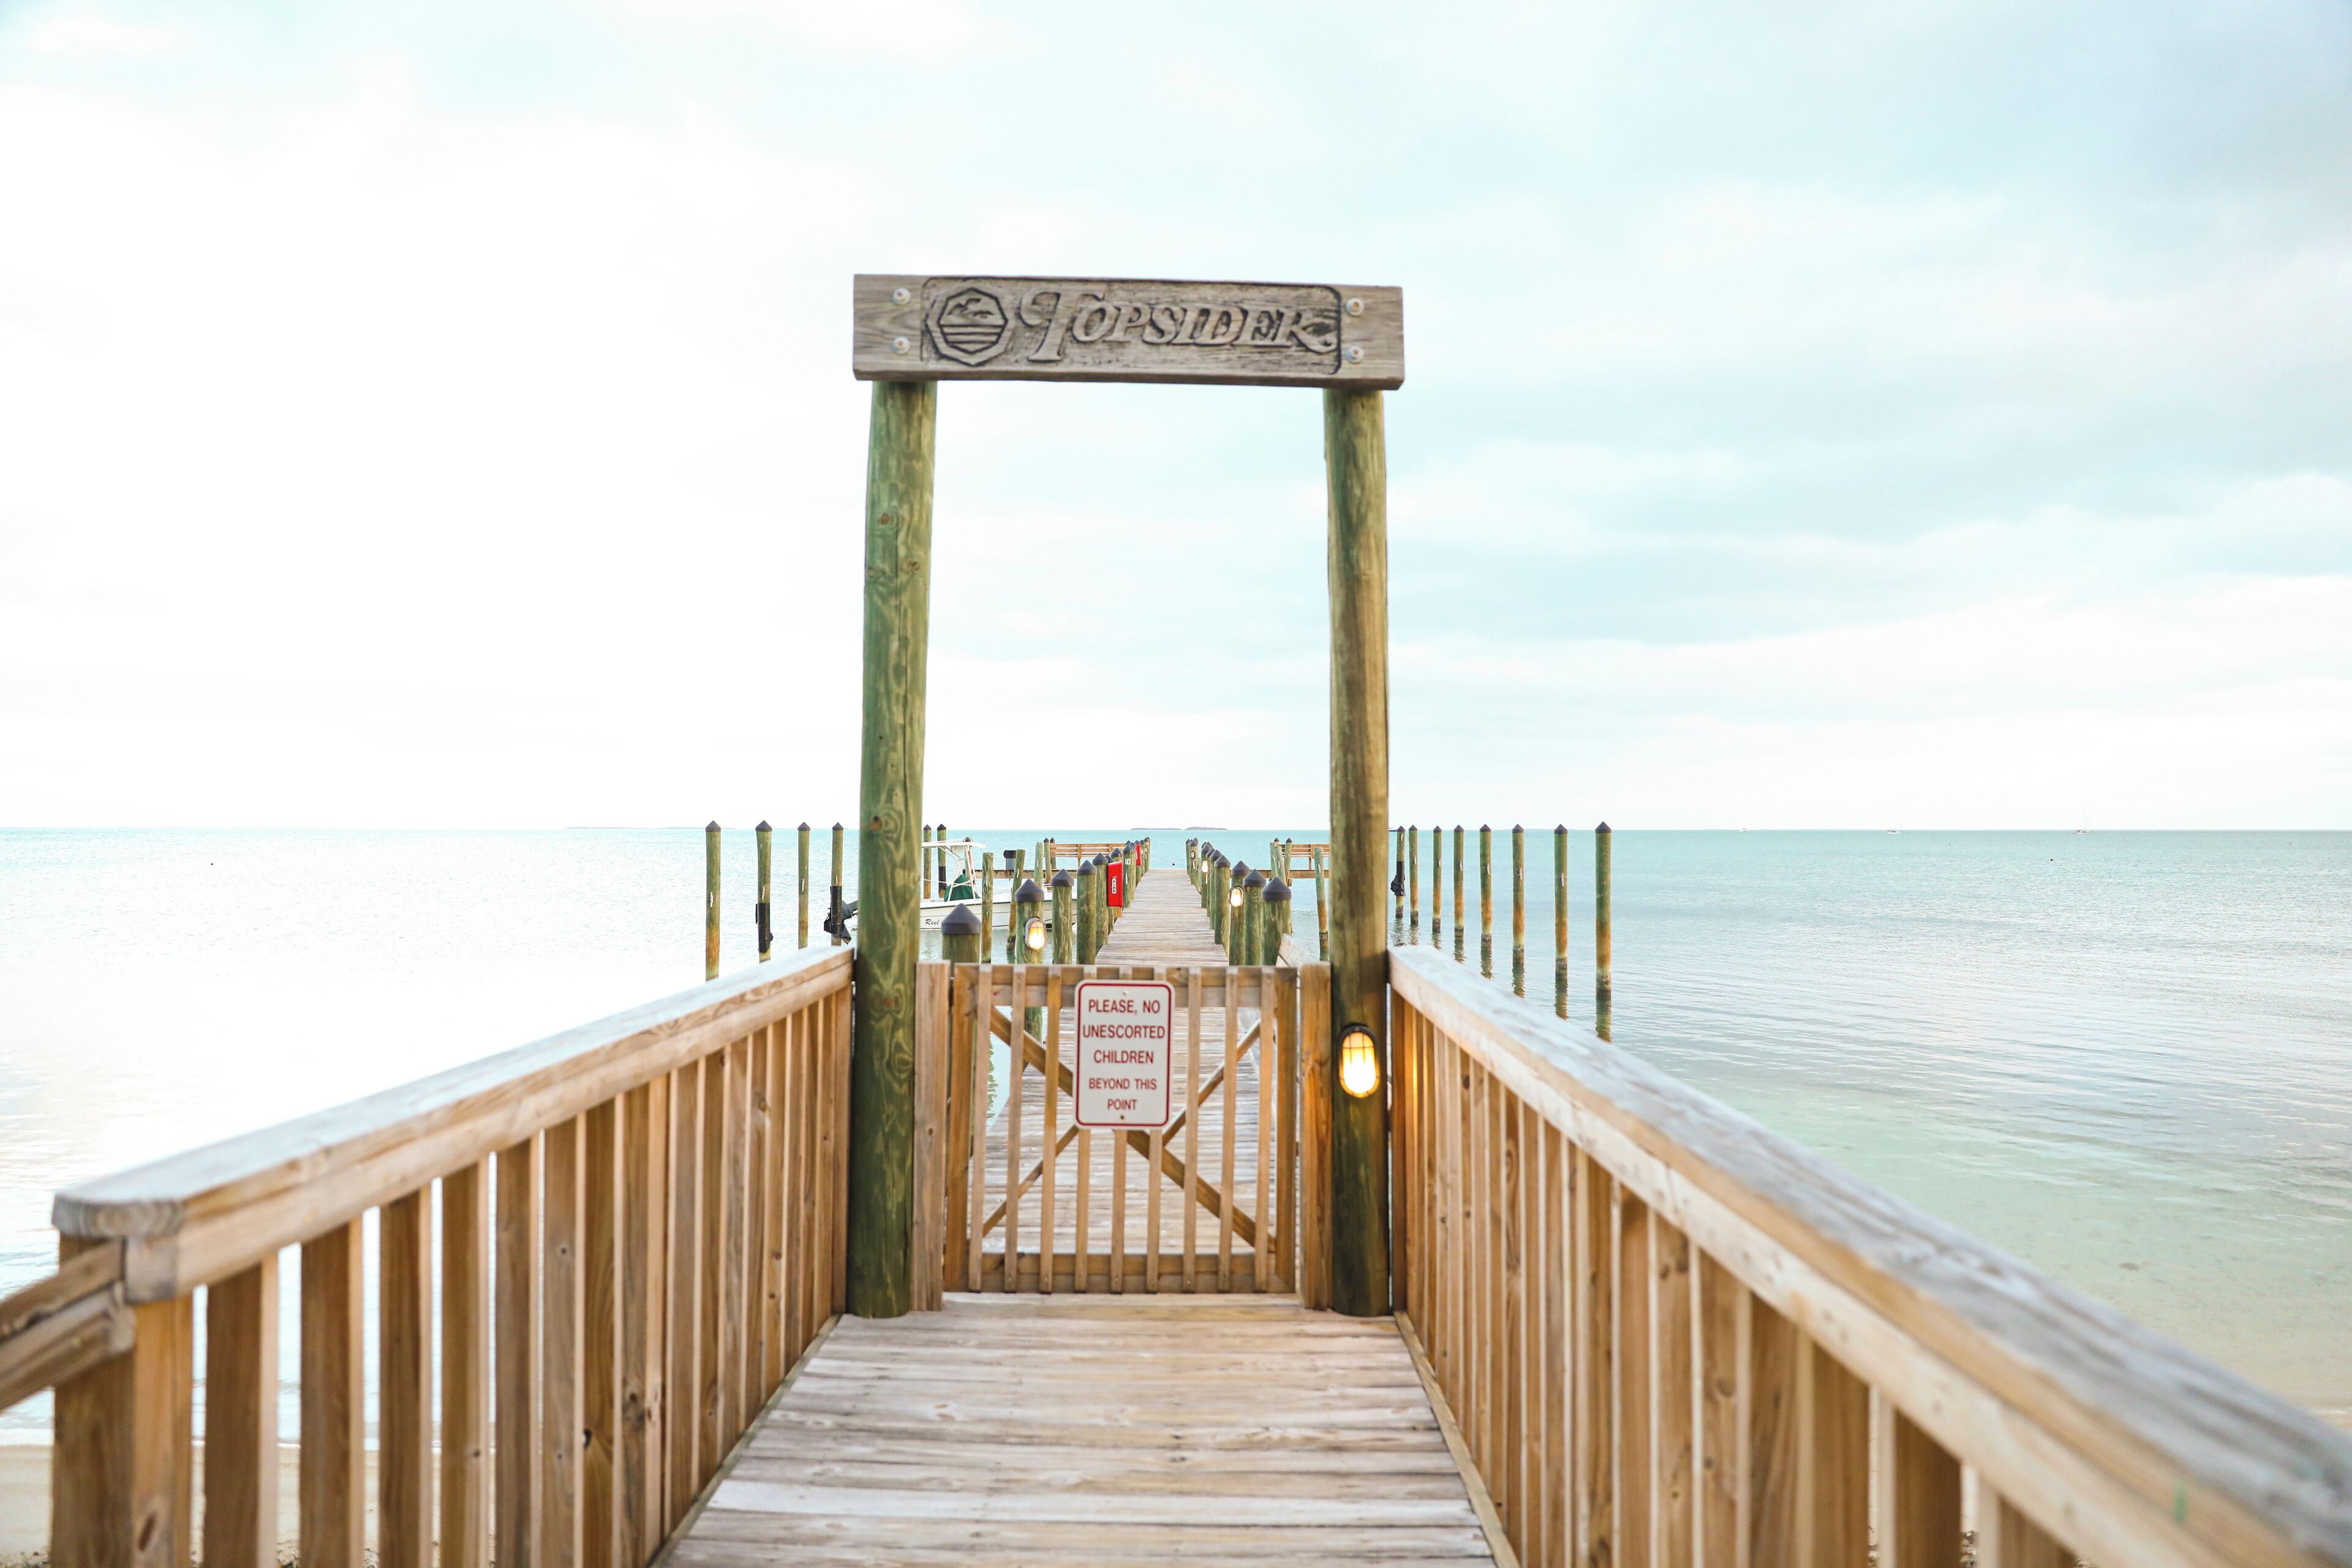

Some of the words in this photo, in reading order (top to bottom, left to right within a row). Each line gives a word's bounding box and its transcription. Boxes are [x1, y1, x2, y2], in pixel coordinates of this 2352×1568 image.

[1088, 999, 1137, 1015] PLEASE,
[1143, 1000, 1160, 1014] NO
[1082, 1025, 1166, 1039] UNESCORTED
[1093, 1050, 1154, 1064] CHILDREN
[1088, 1078, 1130, 1090] BEYOND
[1135, 1079, 1157, 1090] THIS
[1107, 1099, 1137, 1110] POINT
